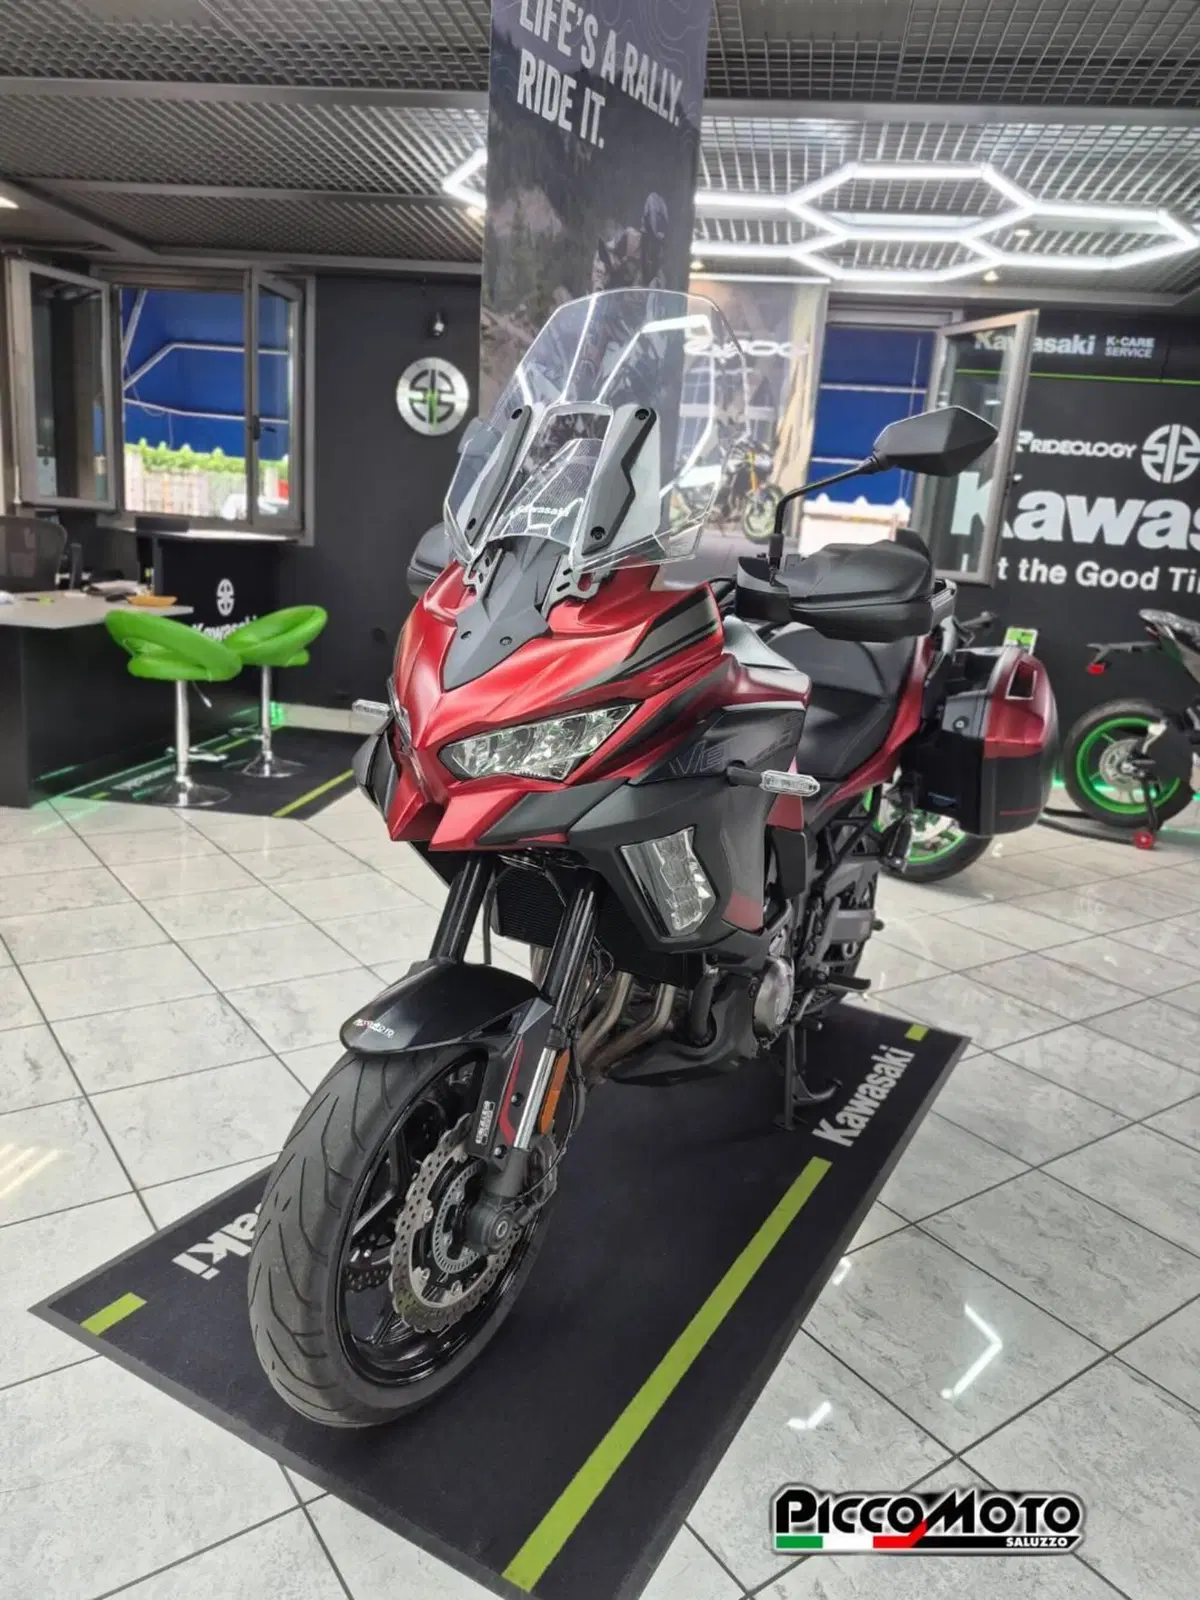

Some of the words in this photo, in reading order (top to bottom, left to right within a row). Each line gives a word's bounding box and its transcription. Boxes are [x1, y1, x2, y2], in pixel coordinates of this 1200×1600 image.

[519, 0, 599, 69] LIFE'S
[600, 29, 617, 85] A
[621, 41, 683, 127] RALLY.
[516, 48, 577, 132] RIDE
[580, 87, 606, 149] IT.
[974, 333, 1096, 356] Kaasaki
[1105, 347, 1152, 358] SERVICE
[1018, 558, 1067, 585] the
[1075, 560, 1160, 592] Good
[1168, 566, 1200, 594] Ti
[811, 1044, 916, 1148] Kawasaki
